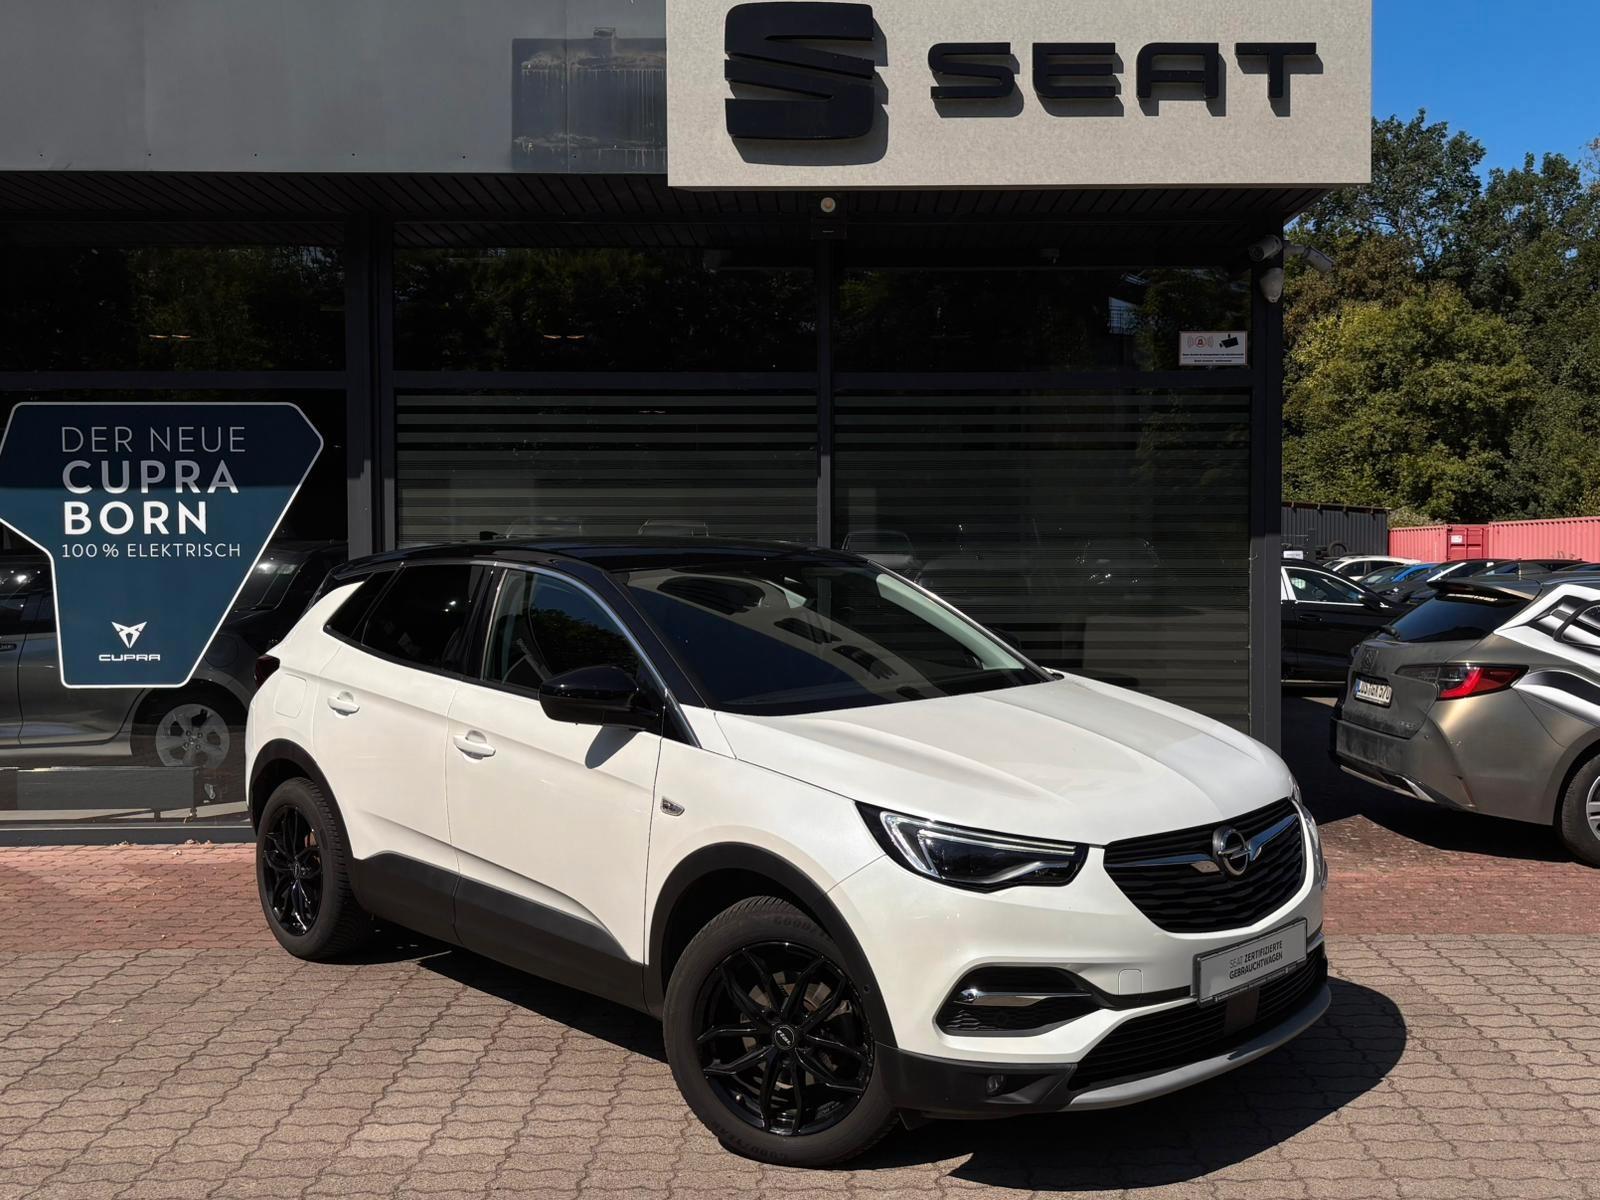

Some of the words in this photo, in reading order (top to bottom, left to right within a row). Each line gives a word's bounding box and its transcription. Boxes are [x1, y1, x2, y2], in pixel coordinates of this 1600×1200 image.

[927, 42, 1318, 100] SEAT
[61, 426, 133, 453] DER
[150, 426, 246, 453] NEUE
[62, 459, 240, 495] CUPRA
[63, 500, 207, 536] BORN
[127, 543, 241, 558] ELEKTRISCH
[98, 653, 161, 662] CUPRA
[1229, 951, 1283, 979] GEBRAUCHTWAGEN
[1244, 940, 1283, 963] ZERTIFIZIERTE
